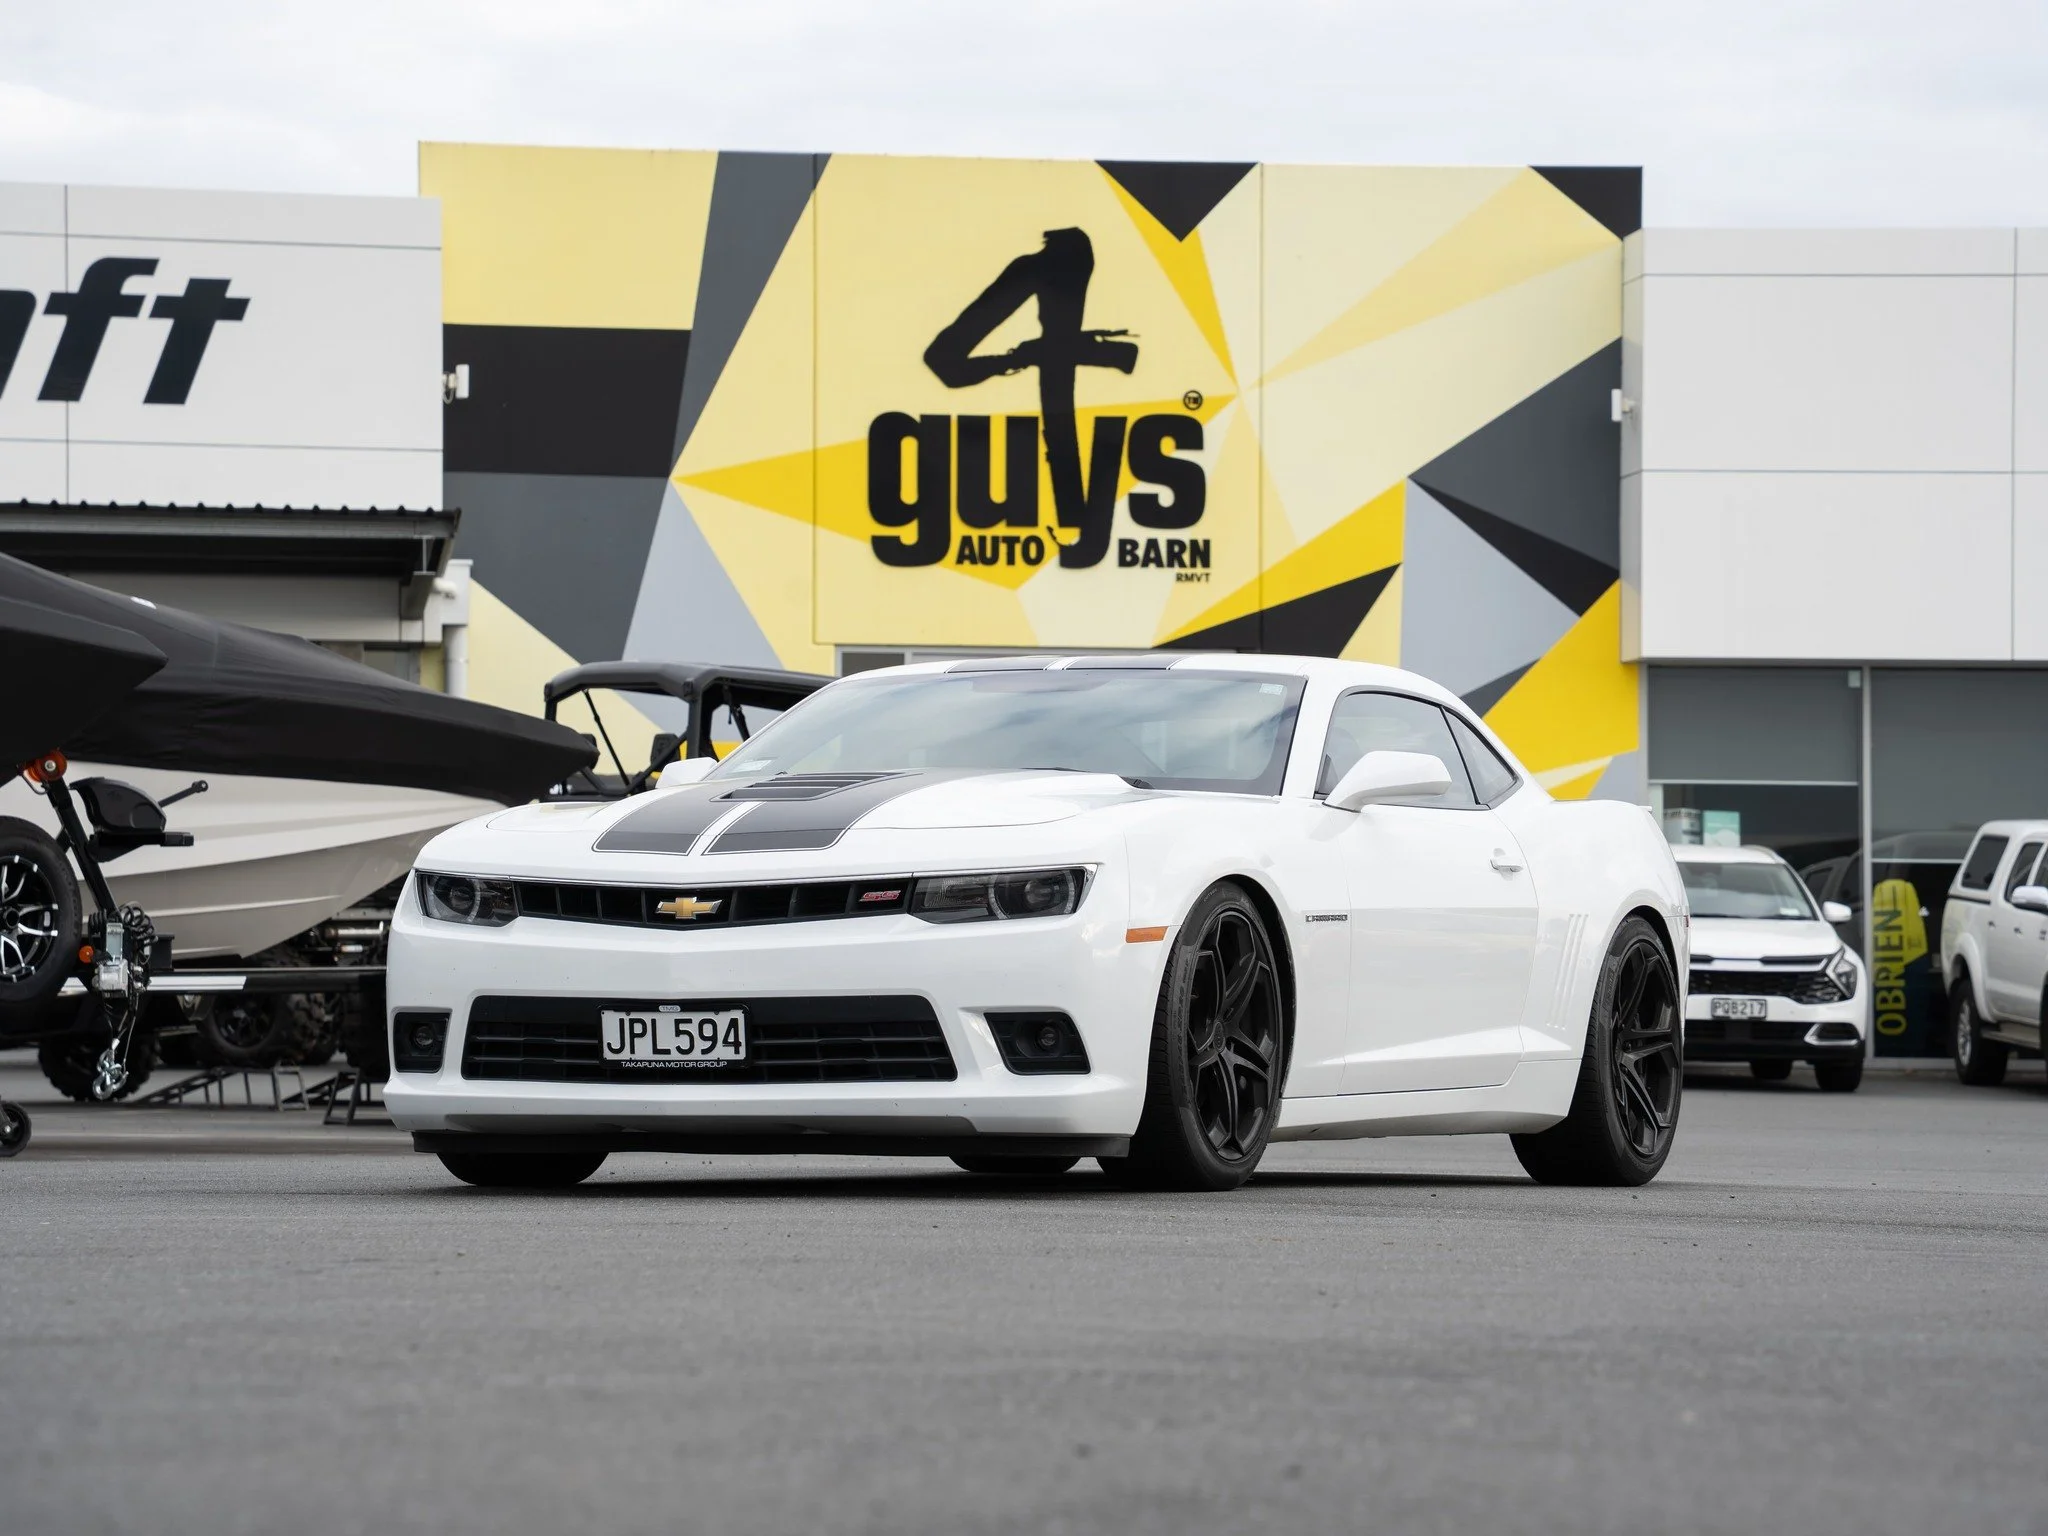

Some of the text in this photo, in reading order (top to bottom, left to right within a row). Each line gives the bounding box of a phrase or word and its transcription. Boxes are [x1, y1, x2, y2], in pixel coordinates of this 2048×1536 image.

[0, 257, 251, 405] ft
[868, 411, 1206, 569] guys
[955, 534, 1211, 569] AUTO BARN
[1175, 572, 1211, 583] RMVT
[606, 1017, 742, 1055] JPL594
[697, 1060, 728, 1068] GROUP
